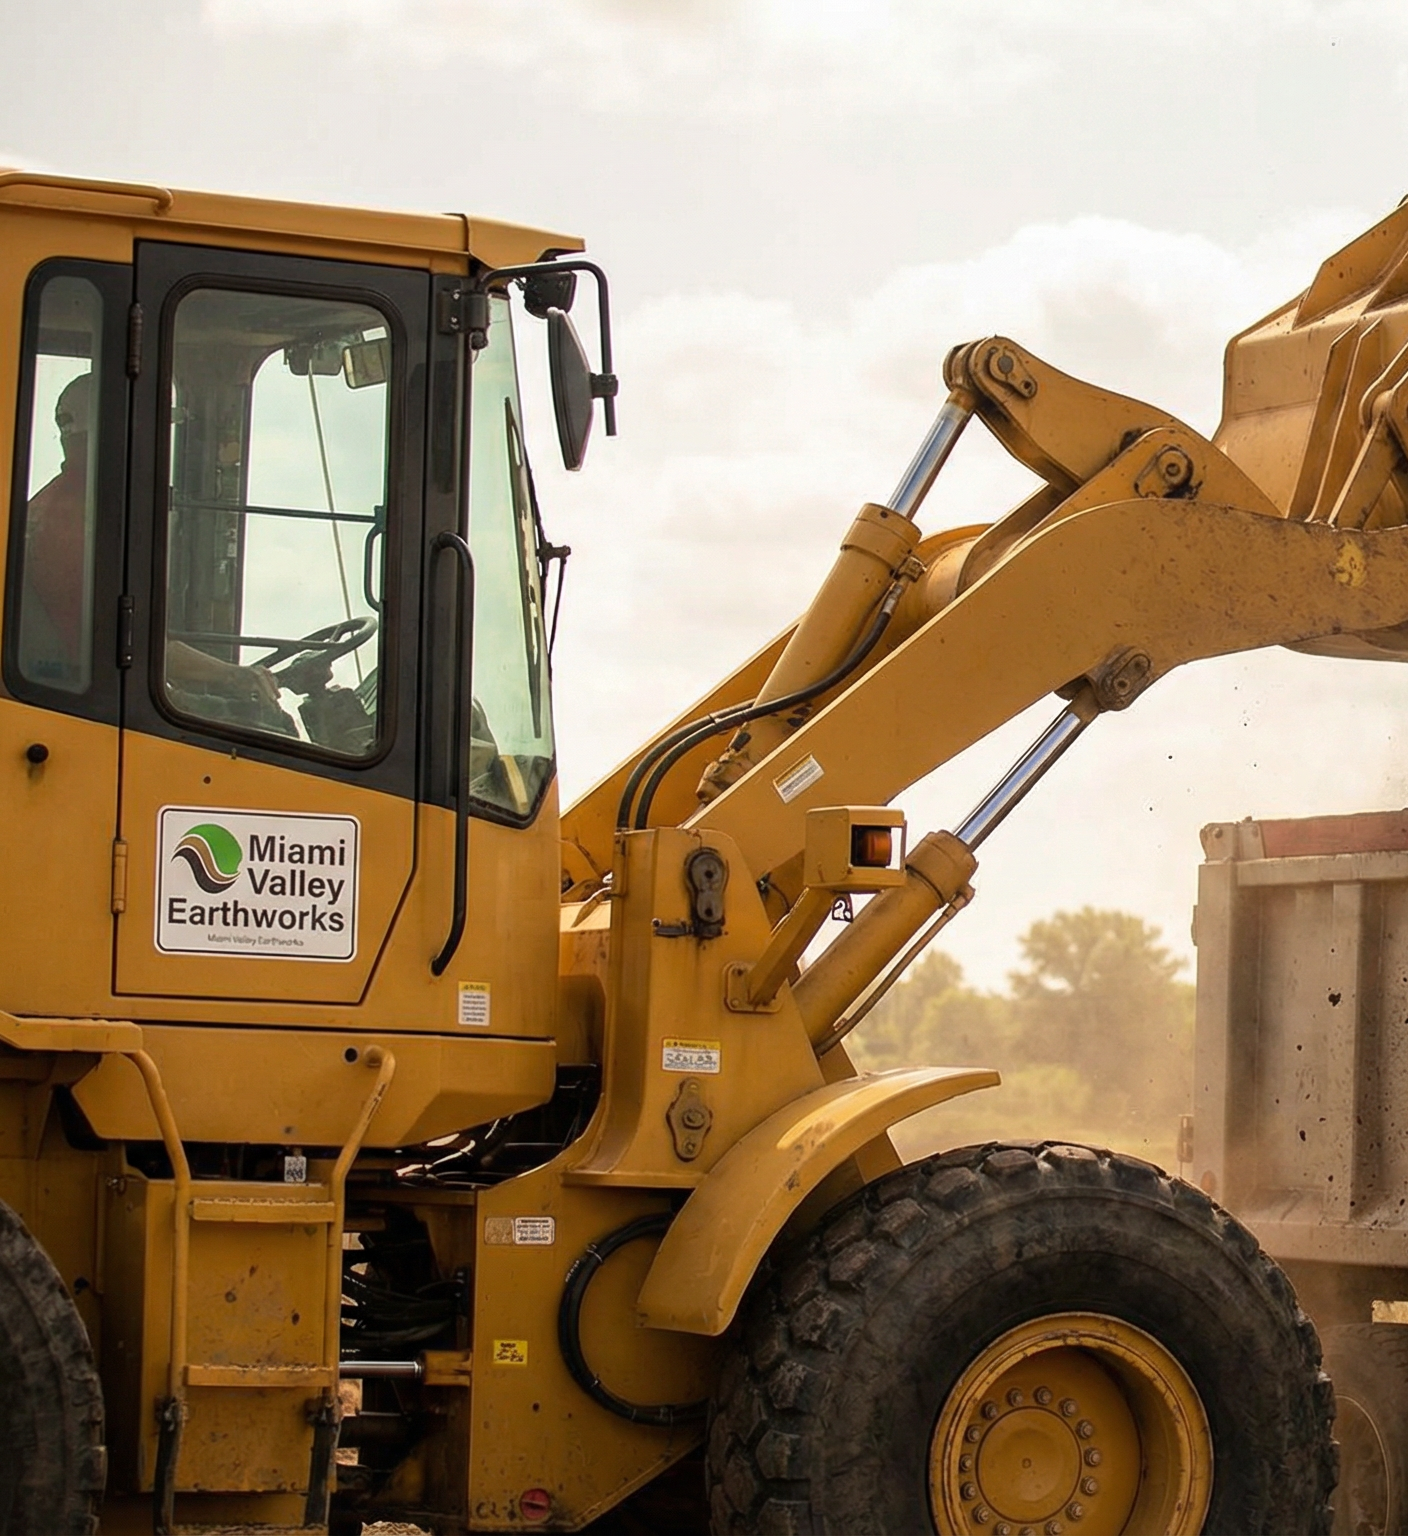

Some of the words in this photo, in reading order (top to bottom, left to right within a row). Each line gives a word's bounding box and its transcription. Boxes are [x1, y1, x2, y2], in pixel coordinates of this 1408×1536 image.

[249, 834, 345, 865] Miami
[247, 868, 345, 905] Valley
[168, 897, 345, 932] Earthworks
